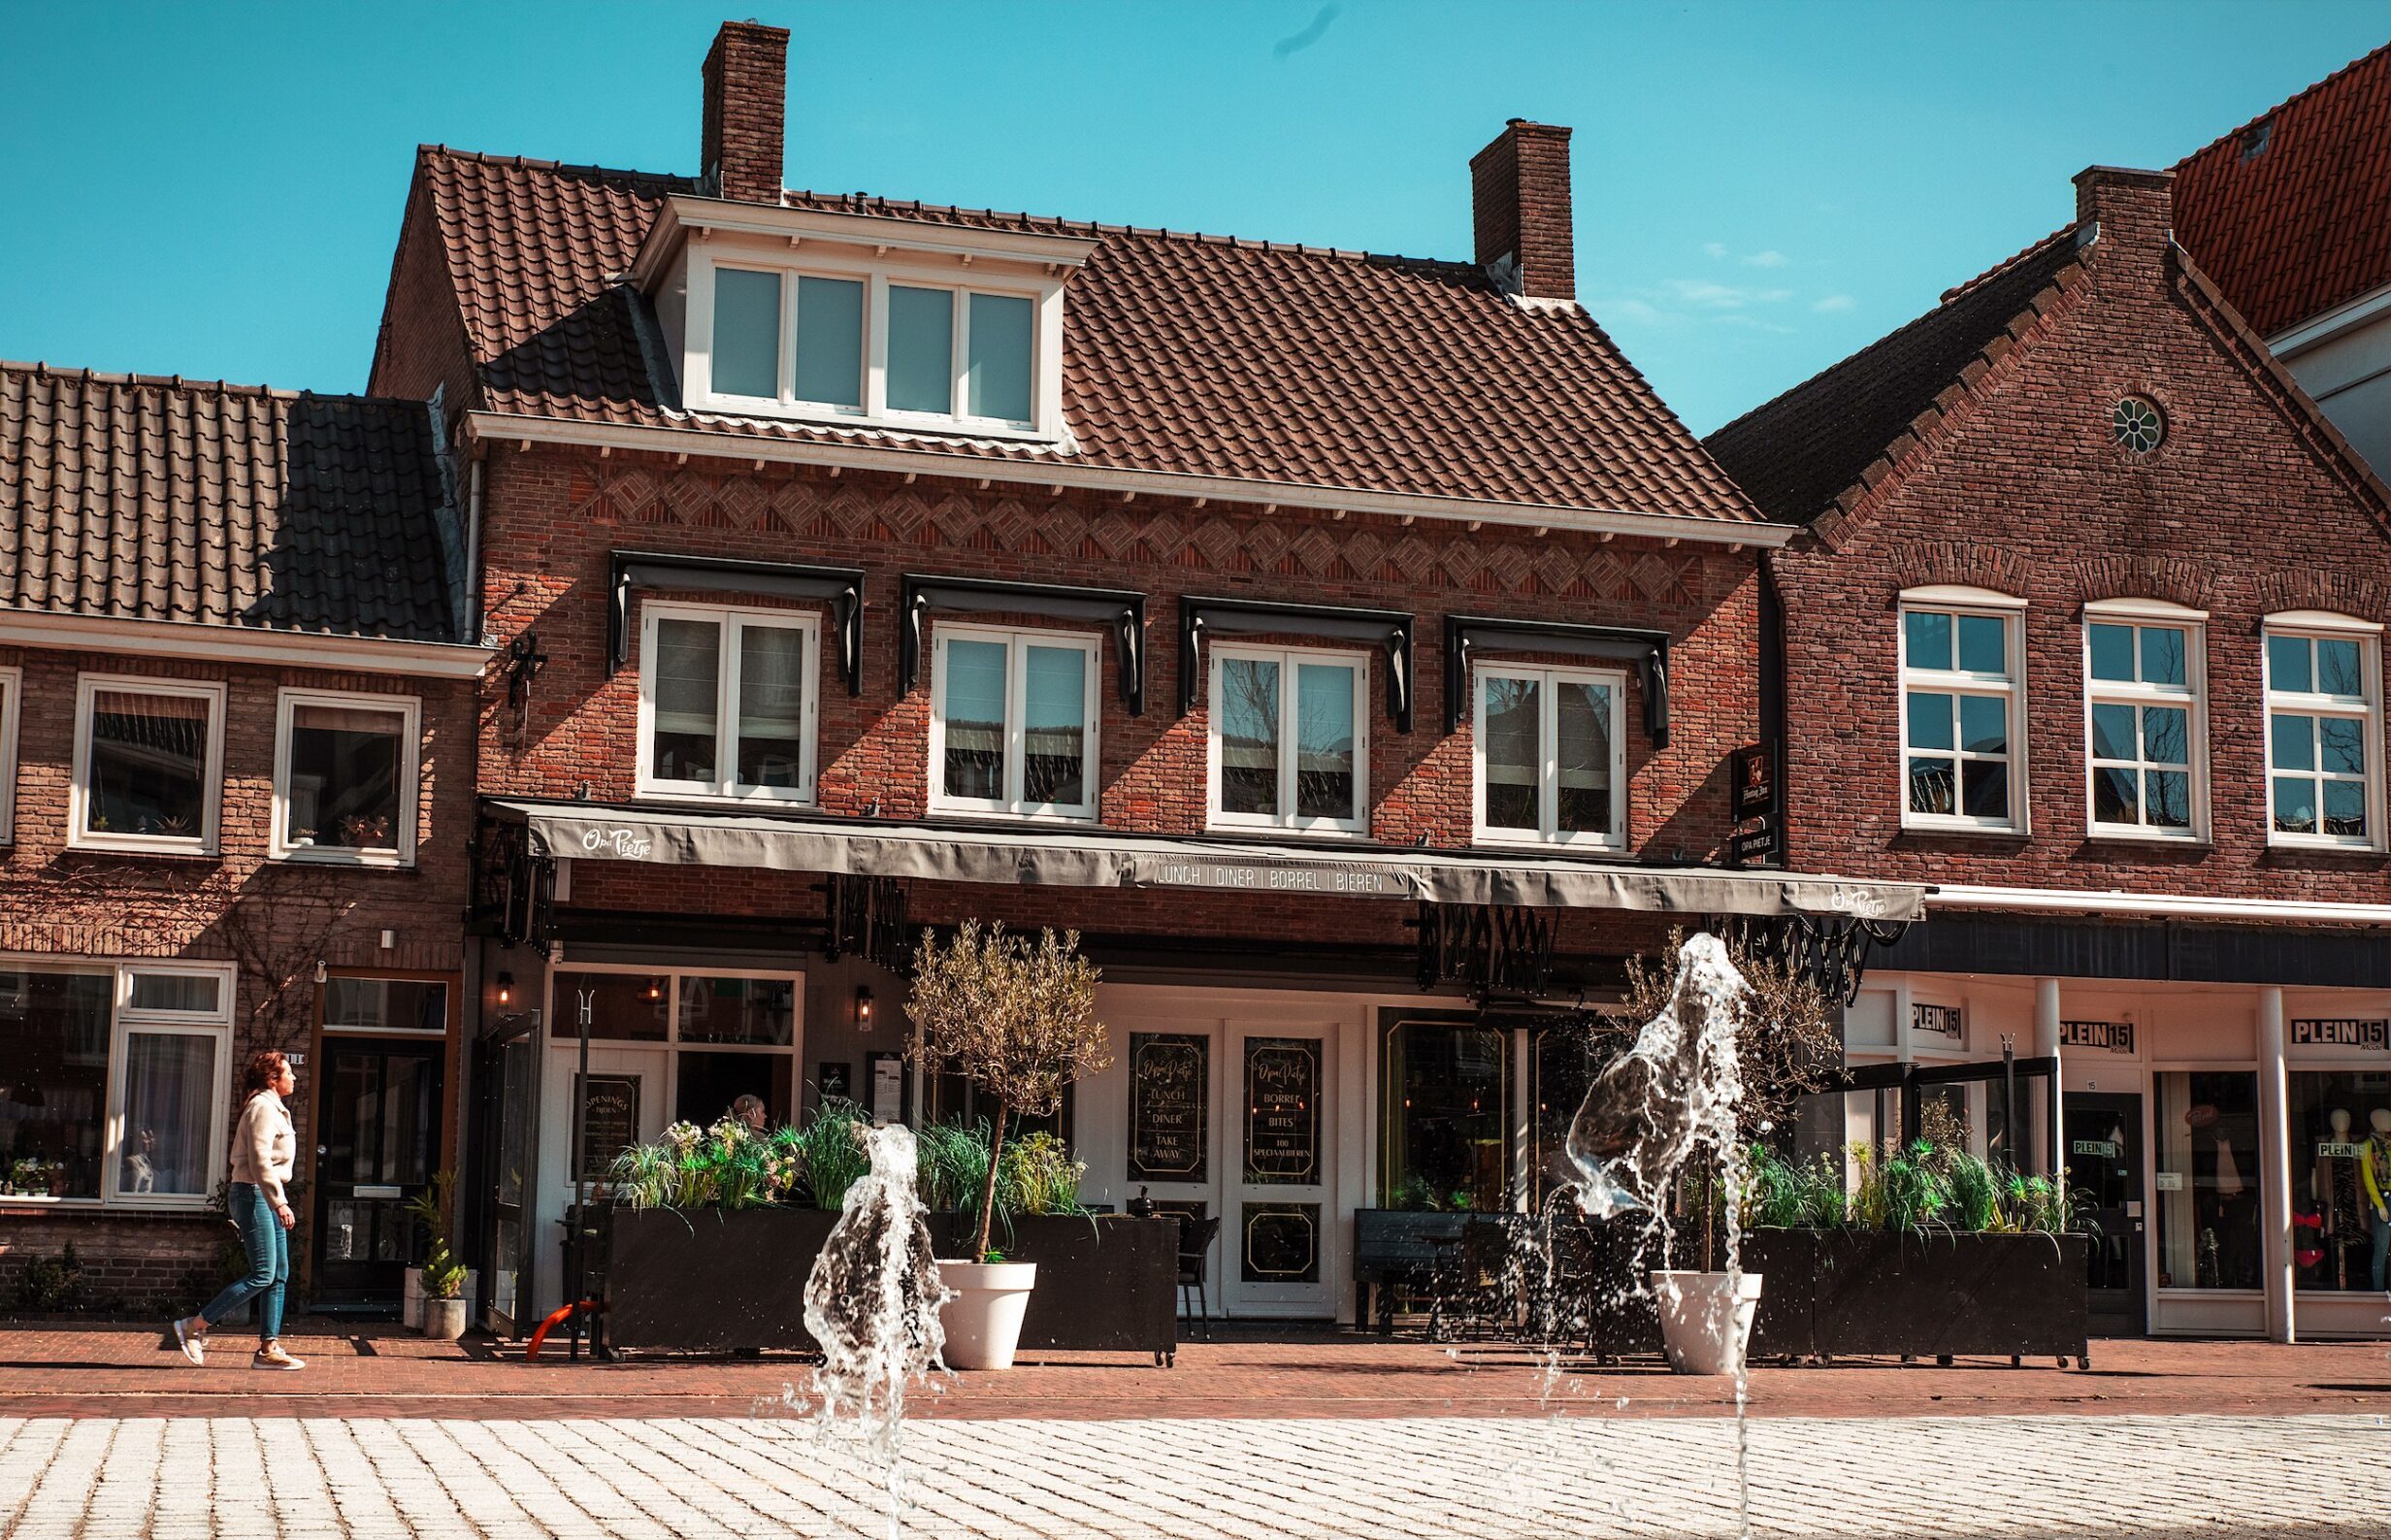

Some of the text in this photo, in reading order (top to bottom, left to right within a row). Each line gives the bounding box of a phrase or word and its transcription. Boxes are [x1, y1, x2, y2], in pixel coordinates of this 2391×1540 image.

[582, 828, 651, 859] Opa Pietje
[1741, 836, 1771, 852] OPA PIETJE
[1158, 866, 1383, 892] LUNCH DINER BORREL BIEREN
[1851, 891, 1885, 917] Pietje
[2087, 1081, 2096, 1090] 15
[1151, 1089, 1185, 1100] LUNCH
[1263, 1094, 1300, 1103] BORREL
[585, 1095, 630, 1111] OPENINGS
[1152, 1113, 1182, 1125] DINER
[1268, 1117, 1294, 1127] BITES
[1155, 1135, 1178, 1146] TAKE
[1153, 1149, 1181, 1159] AWAY
[1253, 1148, 1311, 1158] SPECIAALBIEREN
